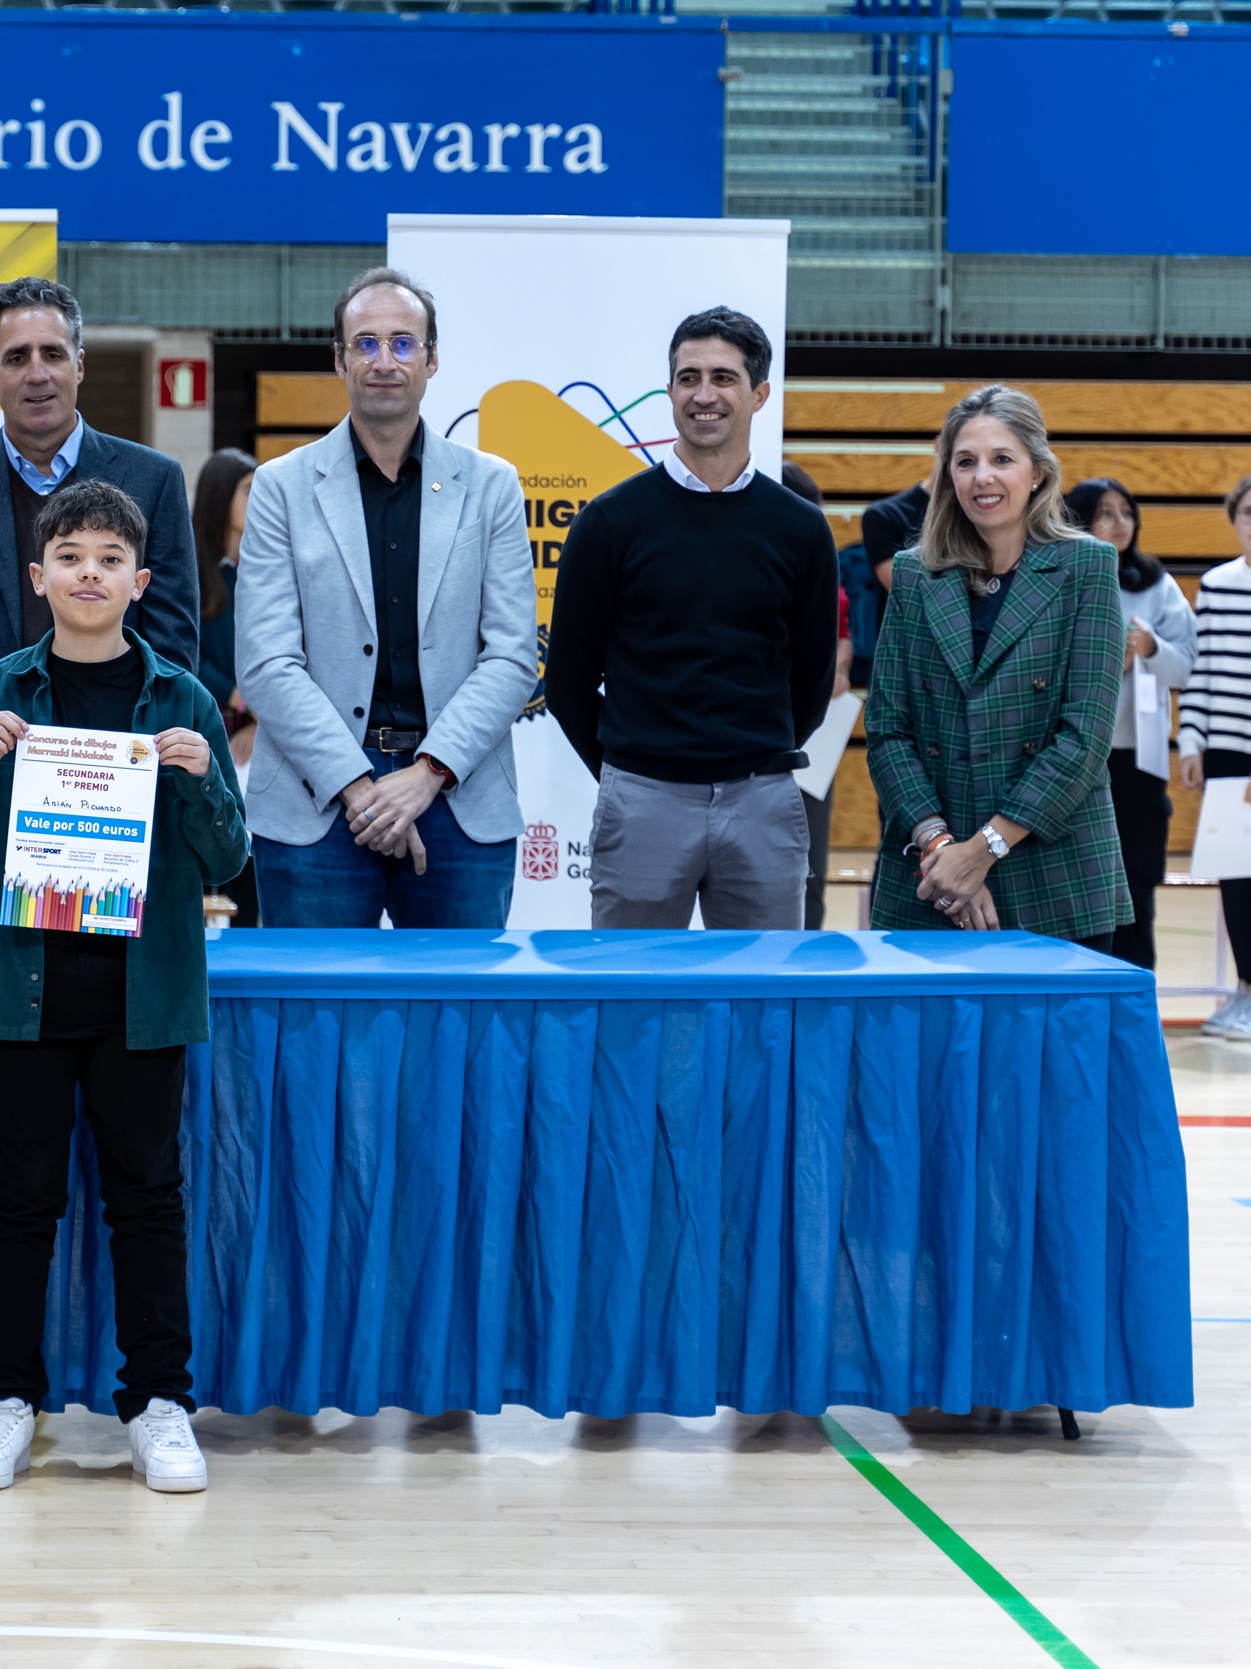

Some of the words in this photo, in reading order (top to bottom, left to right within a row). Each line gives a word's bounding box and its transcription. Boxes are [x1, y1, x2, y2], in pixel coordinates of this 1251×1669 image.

[137, 90, 232, 171] de
[270, 99, 609, 174] Navarra
[519, 474, 587, 488] ndación
[26, 734, 68, 746] Concurso
[70, 738, 82, 746] de
[84, 738, 117, 750] dibujos
[57, 769, 115, 780] SECUNDARIA
[74, 782, 109, 791] PREMIO
[24, 816, 50, 829] Vale
[53, 820, 74, 832] por
[78, 821, 100, 833] 500
[102, 825, 138, 837] euros
